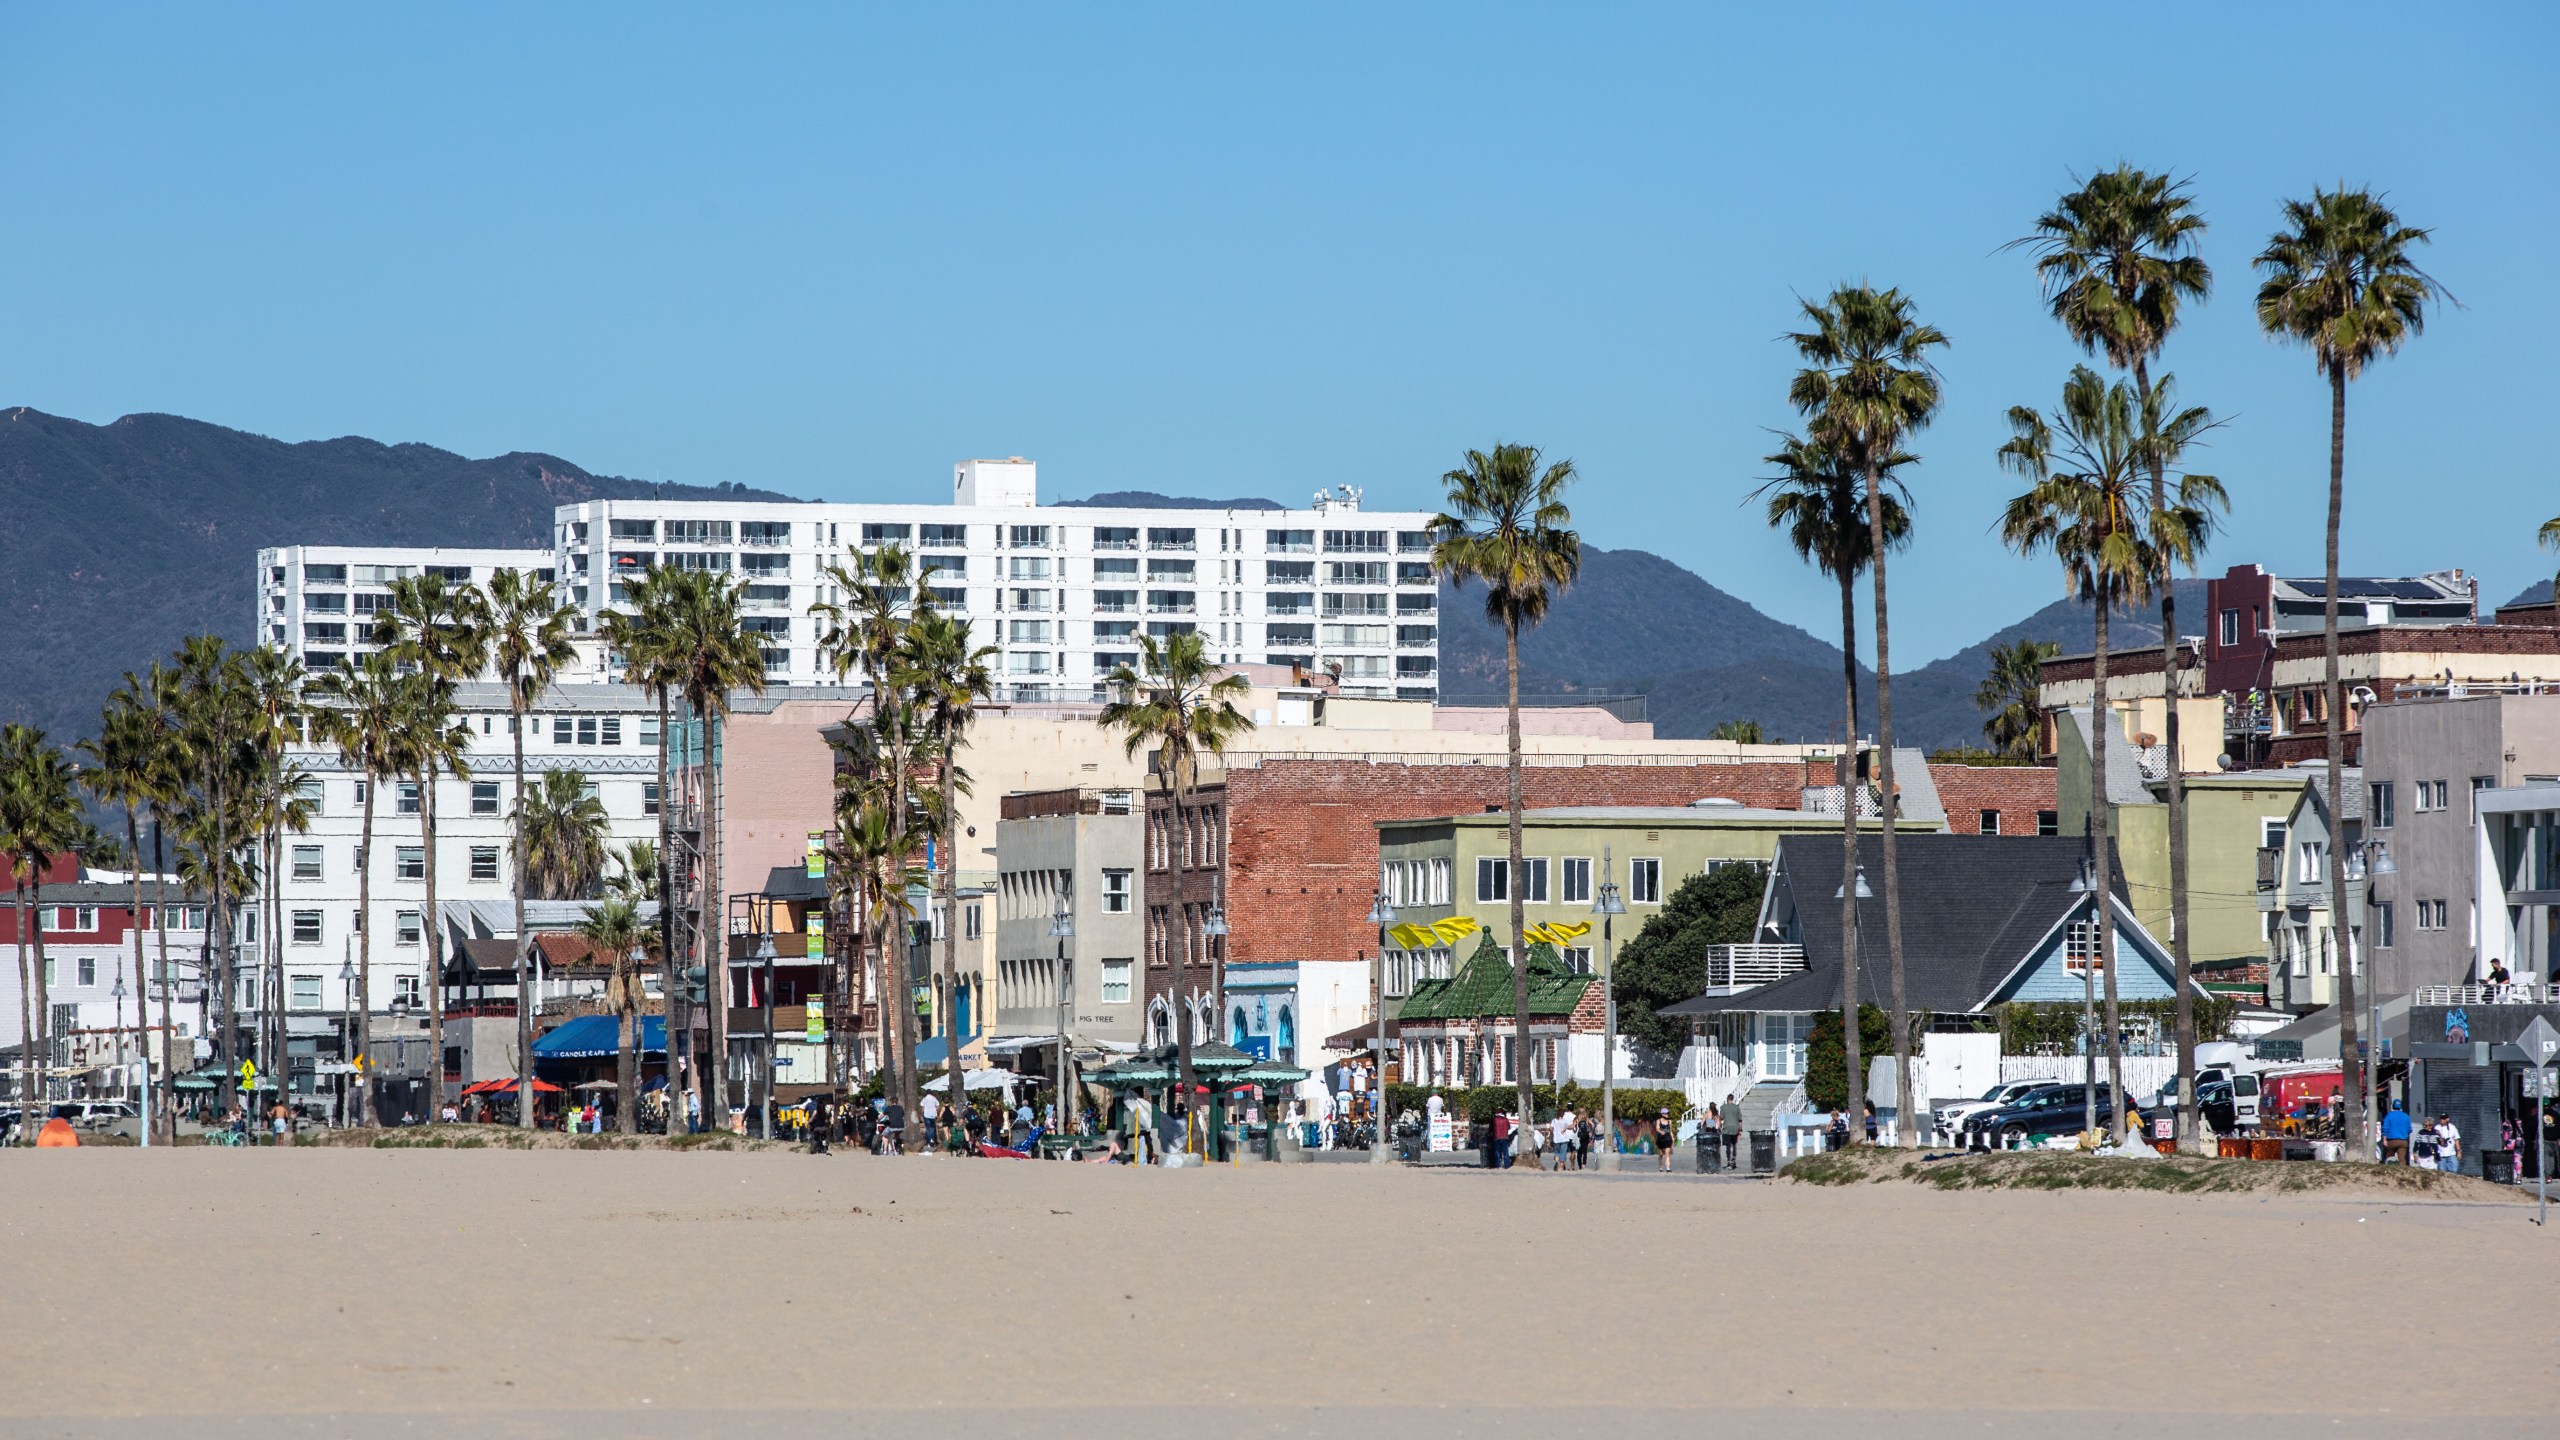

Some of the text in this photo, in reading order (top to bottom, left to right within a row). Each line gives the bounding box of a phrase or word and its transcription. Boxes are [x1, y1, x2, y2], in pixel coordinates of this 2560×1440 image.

[1079, 1015, 1114, 1023] FIG TREE
[958, 1053, 981, 1061] ARKET
[2156, 1122, 2172, 1131] ATM
